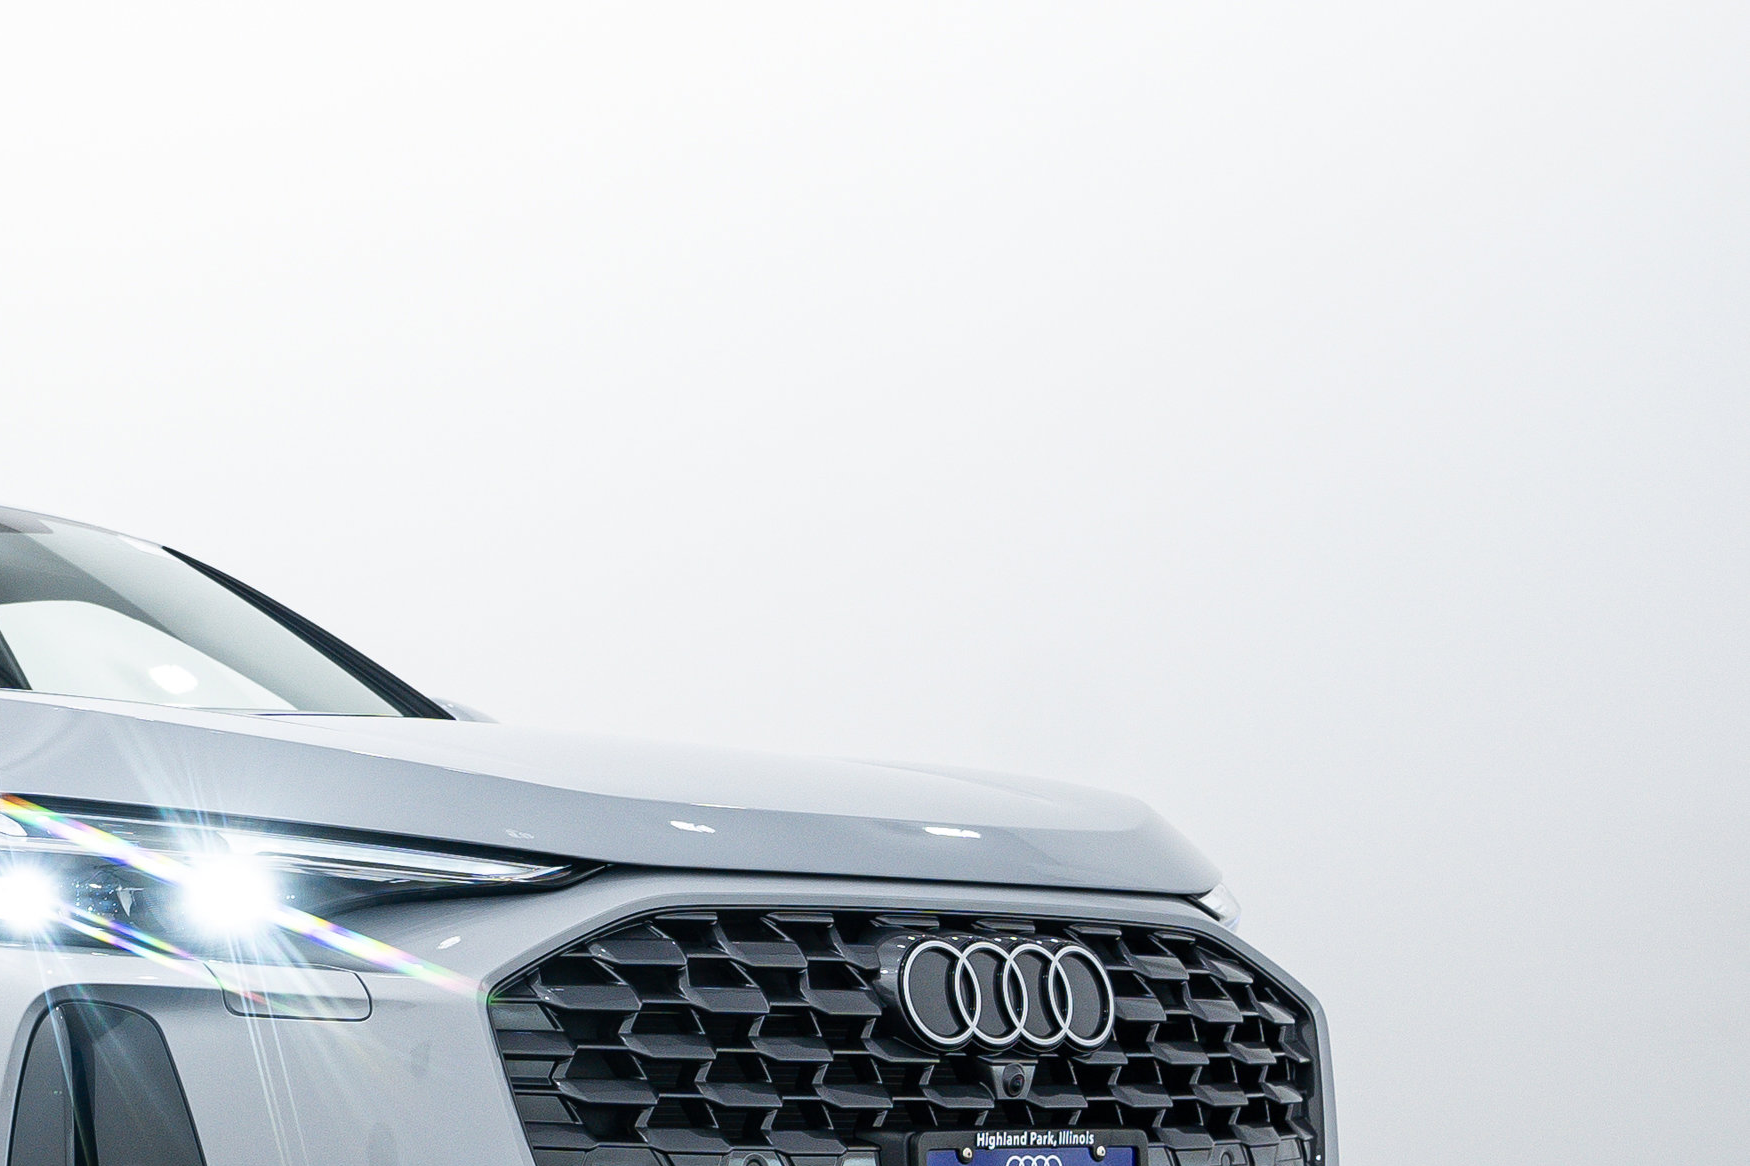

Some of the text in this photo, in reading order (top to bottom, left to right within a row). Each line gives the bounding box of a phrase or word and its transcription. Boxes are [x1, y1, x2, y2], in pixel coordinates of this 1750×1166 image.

[976, 1130, 1095, 1149] Highland Park, Illinois
